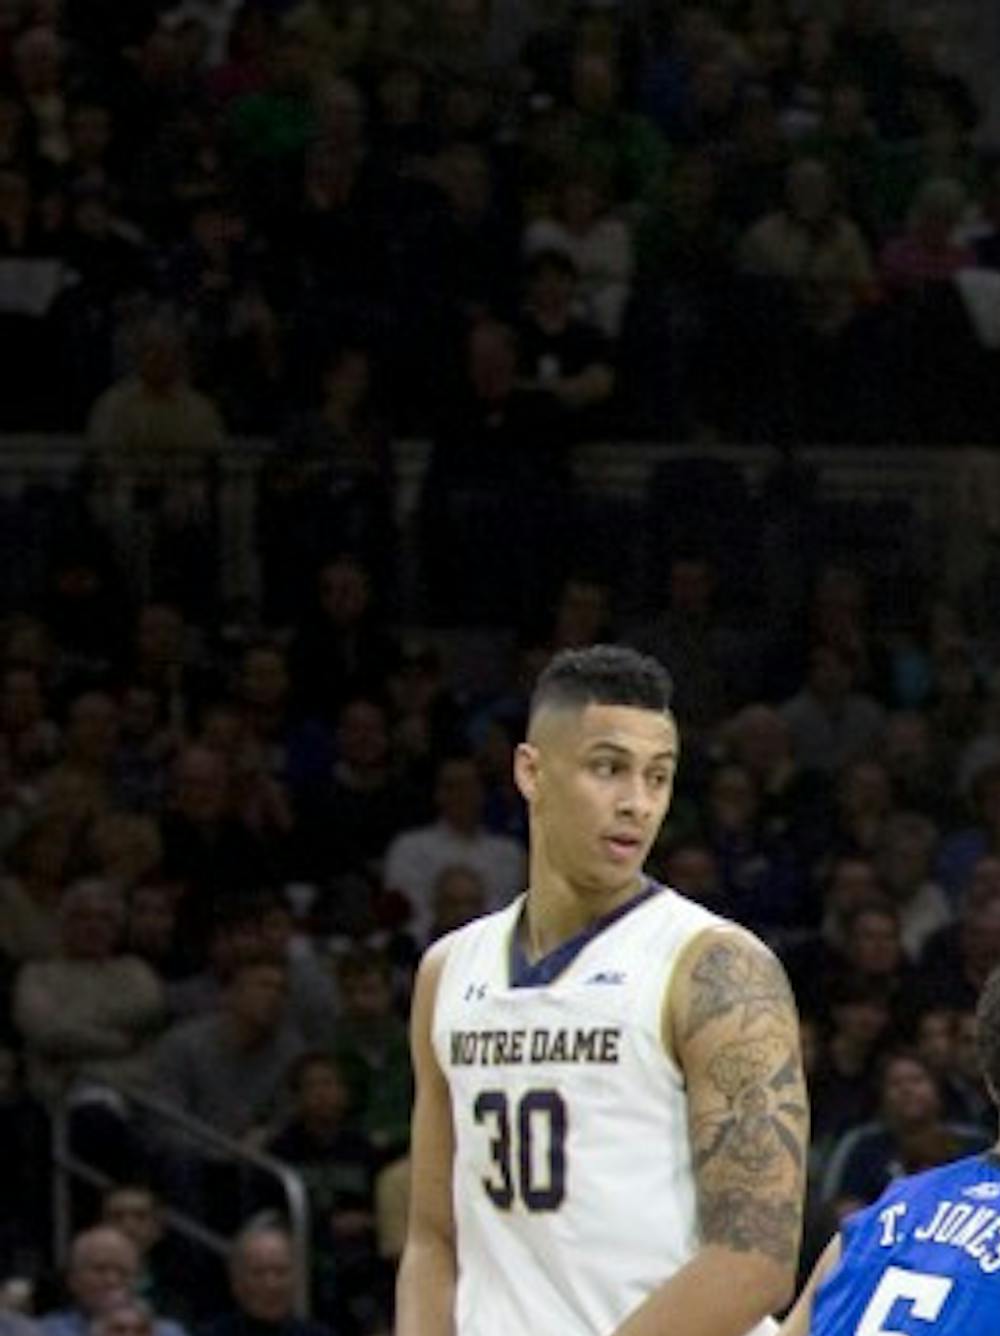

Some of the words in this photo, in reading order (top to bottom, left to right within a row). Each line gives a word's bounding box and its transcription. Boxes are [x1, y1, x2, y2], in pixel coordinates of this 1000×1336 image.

[450, 1028, 527, 1067] NOTRE
[530, 1026, 621, 1065] DAME
[473, 1087, 569, 1214] 30
[877, 1202, 908, 1248] T.
